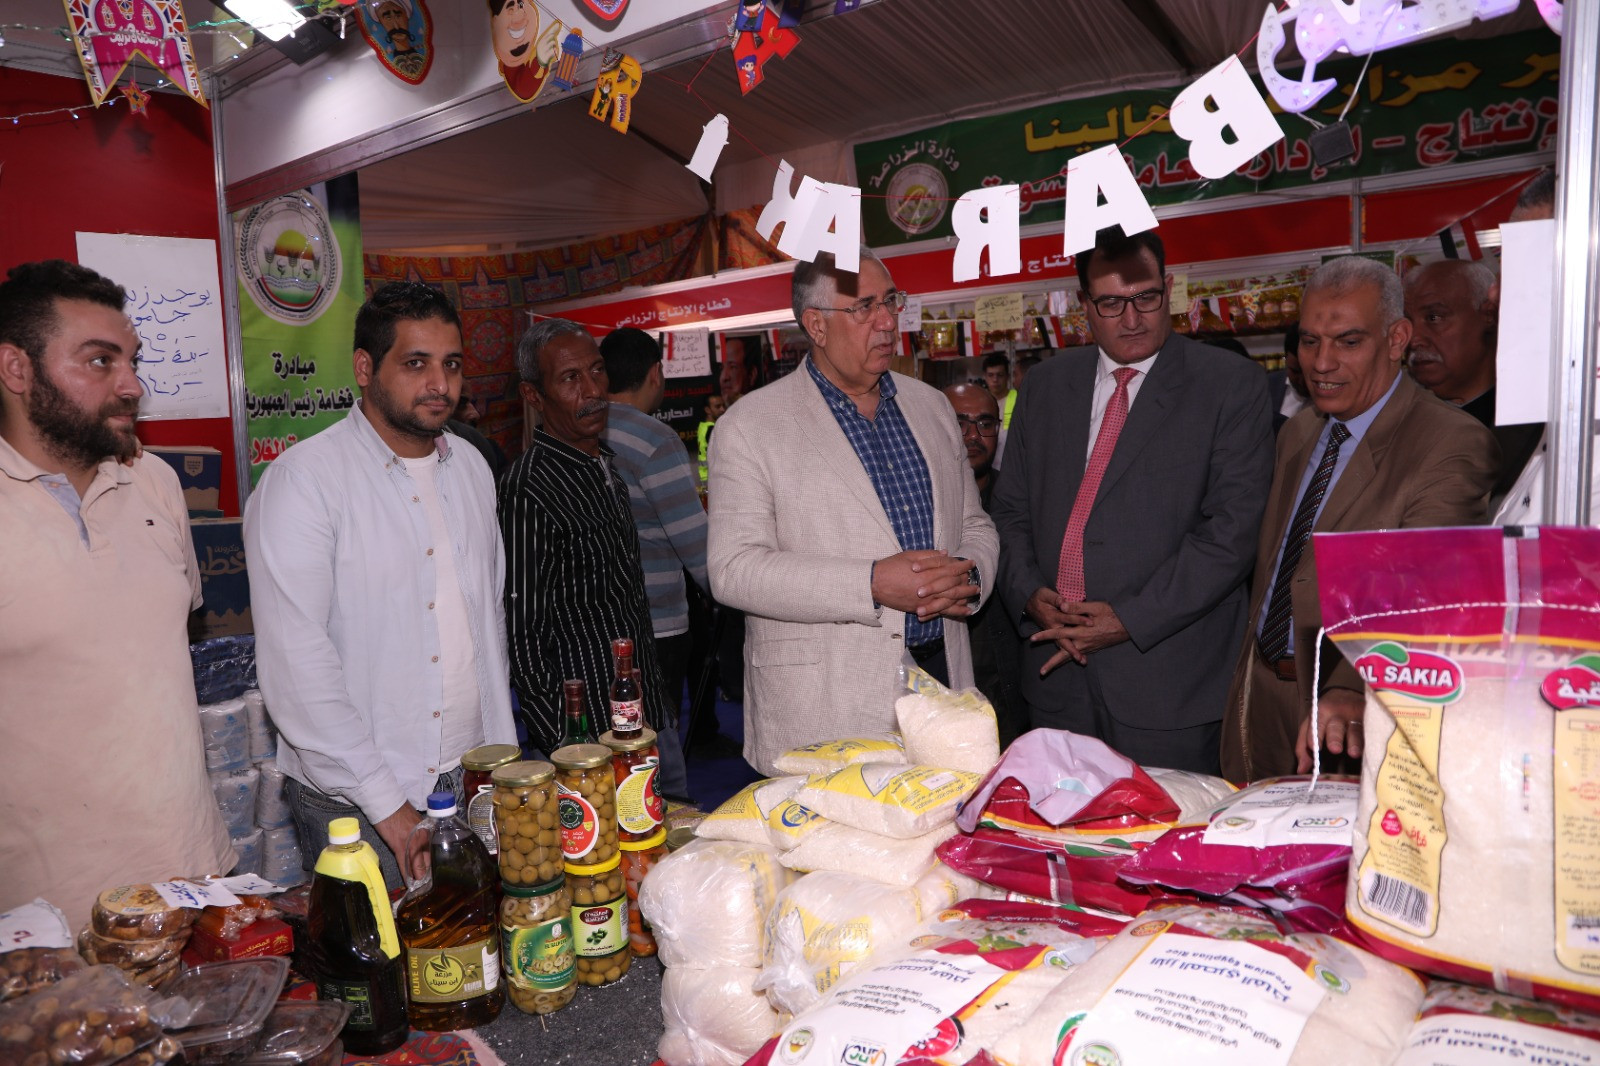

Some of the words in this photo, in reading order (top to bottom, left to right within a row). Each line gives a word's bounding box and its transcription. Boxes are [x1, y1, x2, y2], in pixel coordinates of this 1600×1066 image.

[928, 140, 960, 171] وزارة
[699, 297, 732, 316] قطاع
[271, 351, 316, 382] مبادرة
[290, 389, 316, 418] رئيس
[315, 386, 354, 411] فخامة
[1357, 664, 1378, 683] AL
[1384, 665, 1454, 688] SAKIA
[410, 955, 418, 969] OIL
[1191, 952, 1242, 967] Egyptian
[412, 970, 421, 995] OLIVE
[1240, 975, 1292, 1003] الفاخر
[1244, 963, 1292, 992] Premium
